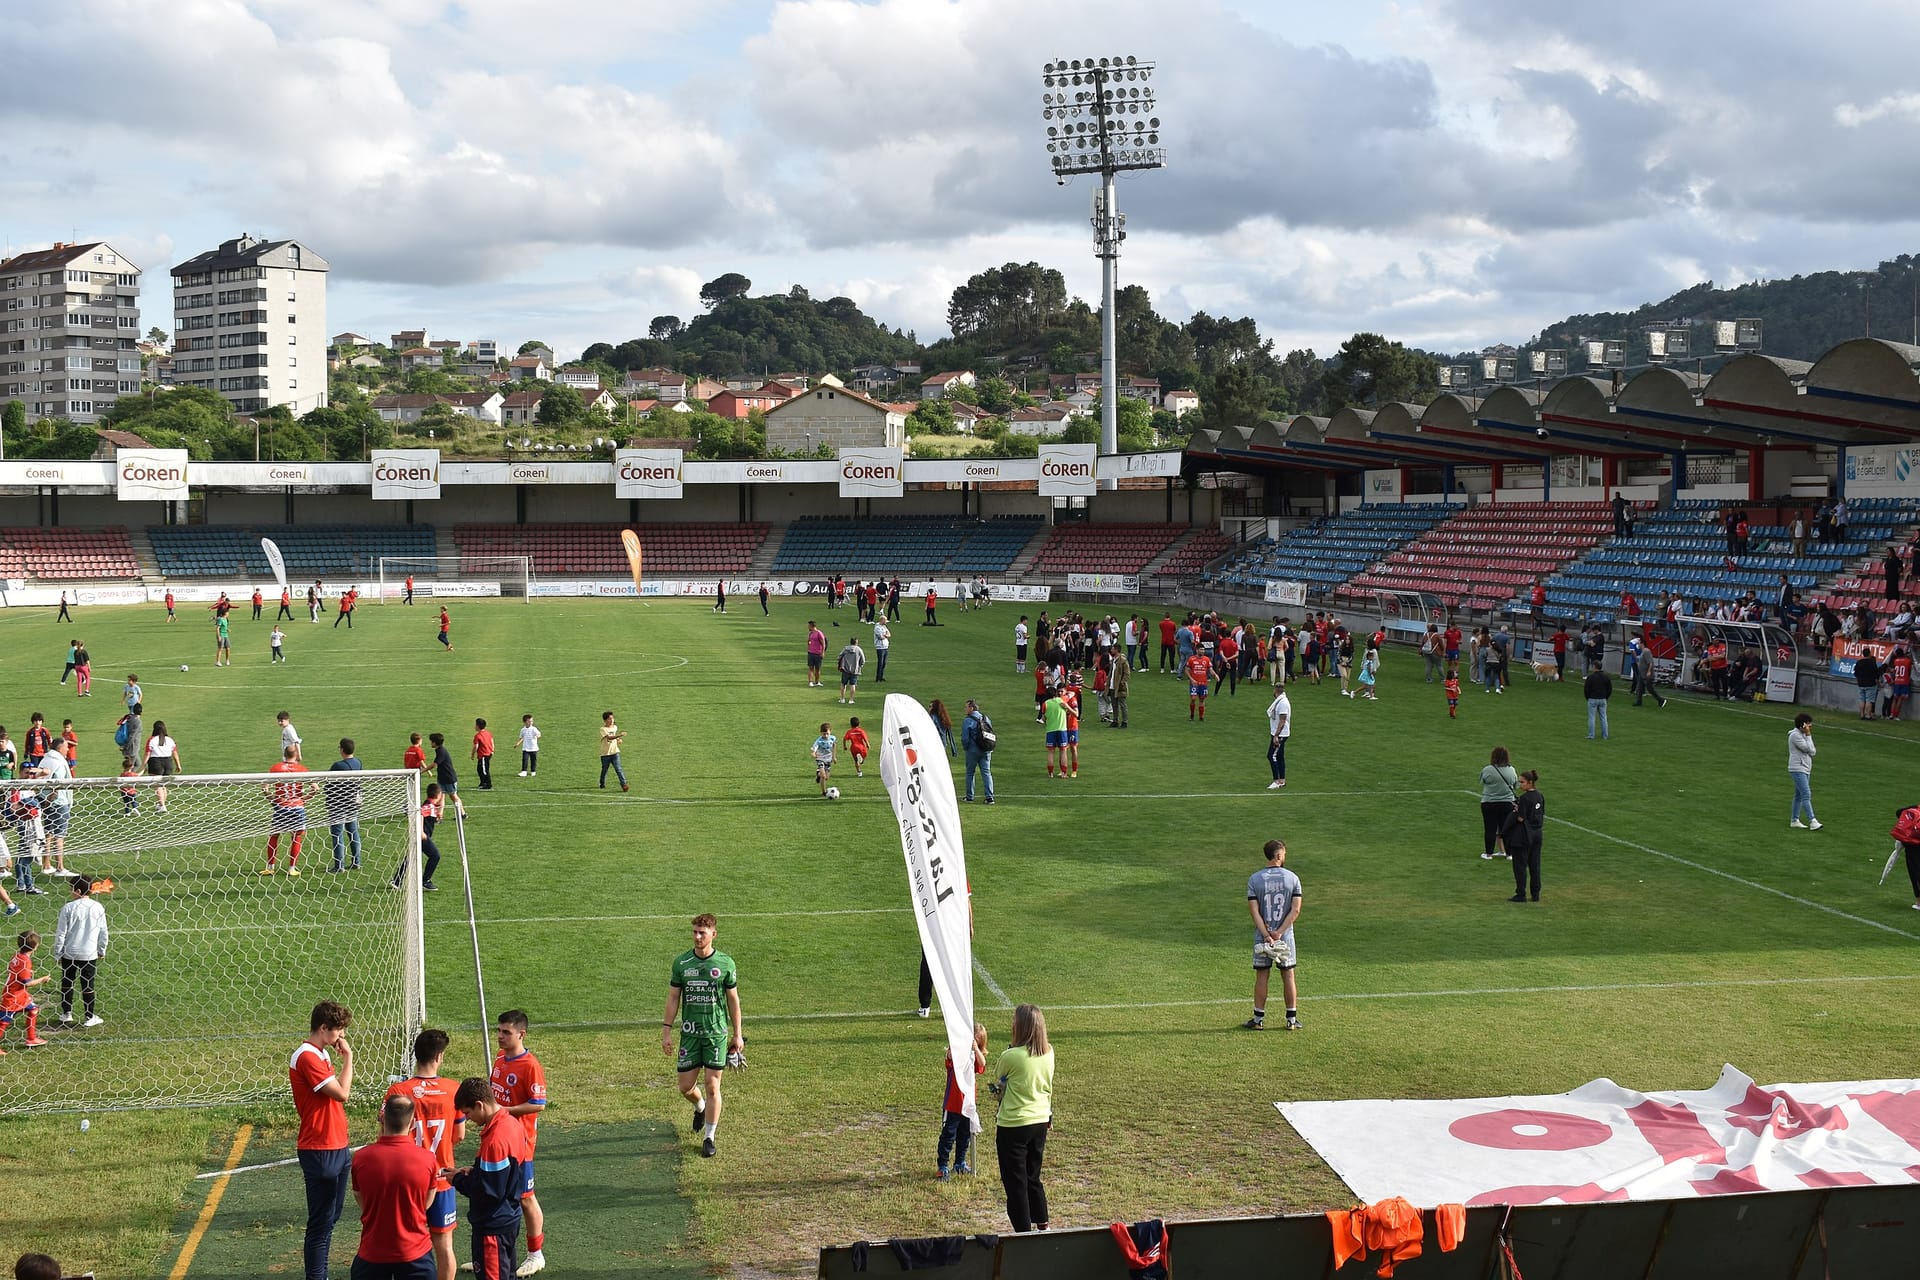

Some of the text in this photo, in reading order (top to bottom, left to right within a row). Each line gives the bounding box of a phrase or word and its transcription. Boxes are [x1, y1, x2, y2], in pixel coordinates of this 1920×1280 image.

[1894, 665, 1906, 677] 20
[1263, 893, 1285, 922] 13
[411, 1119, 446, 1157] 17
